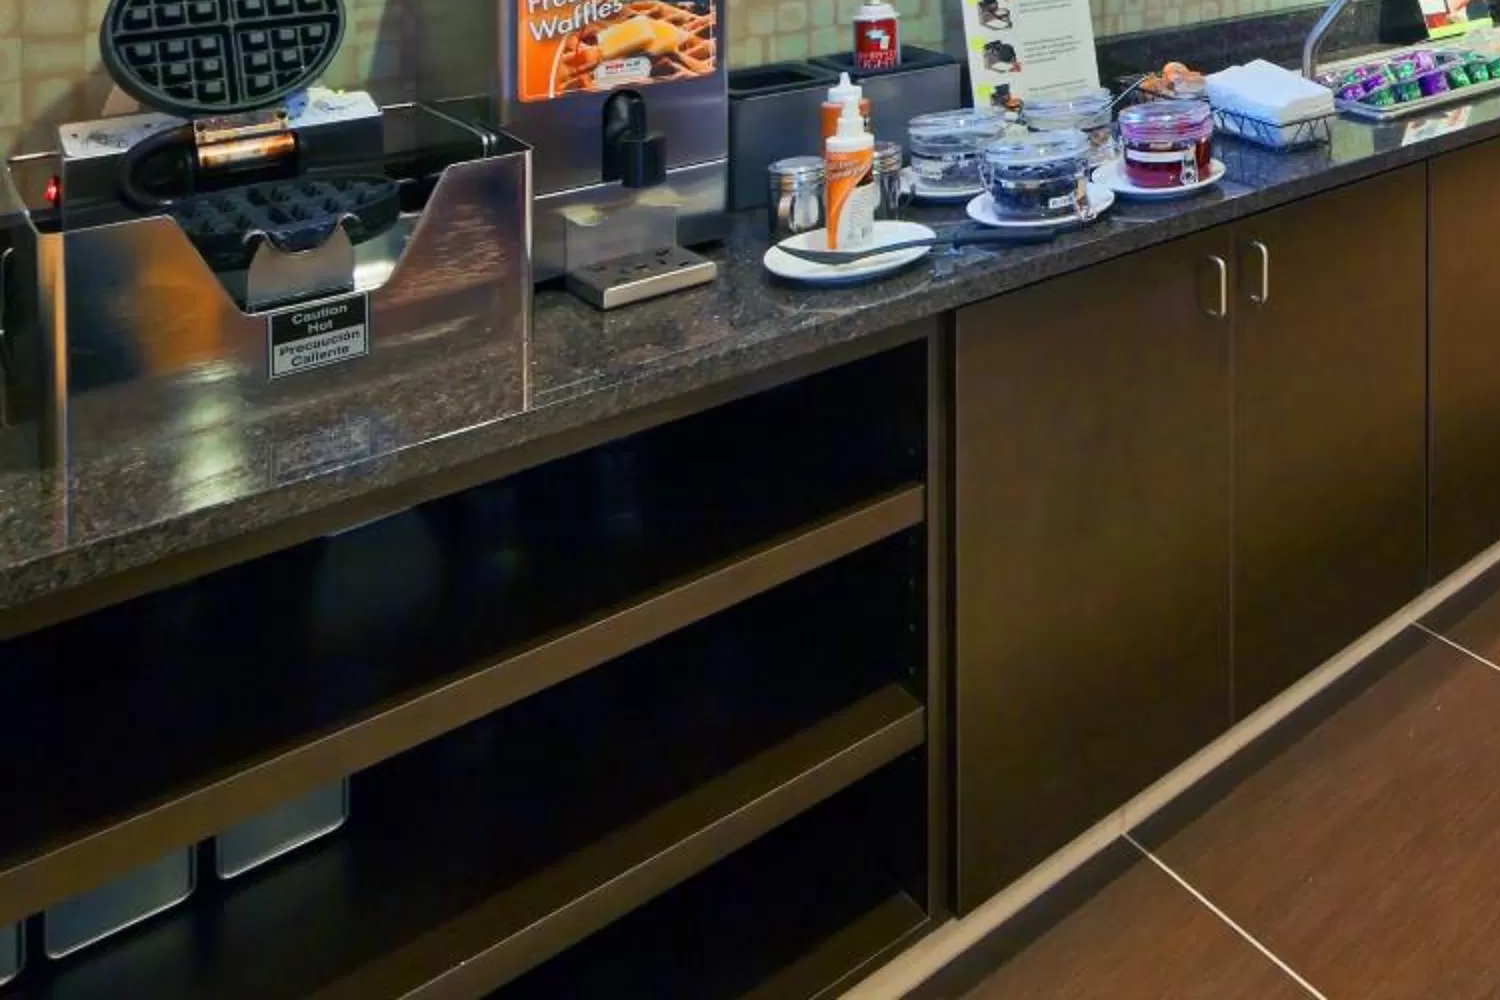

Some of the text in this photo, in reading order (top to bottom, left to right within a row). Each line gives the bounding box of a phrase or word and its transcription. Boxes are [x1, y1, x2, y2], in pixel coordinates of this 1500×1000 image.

[291, 303, 349, 325] Caution
[307, 319, 334, 335] Hot
[291, 345, 350, 367] Caliente
